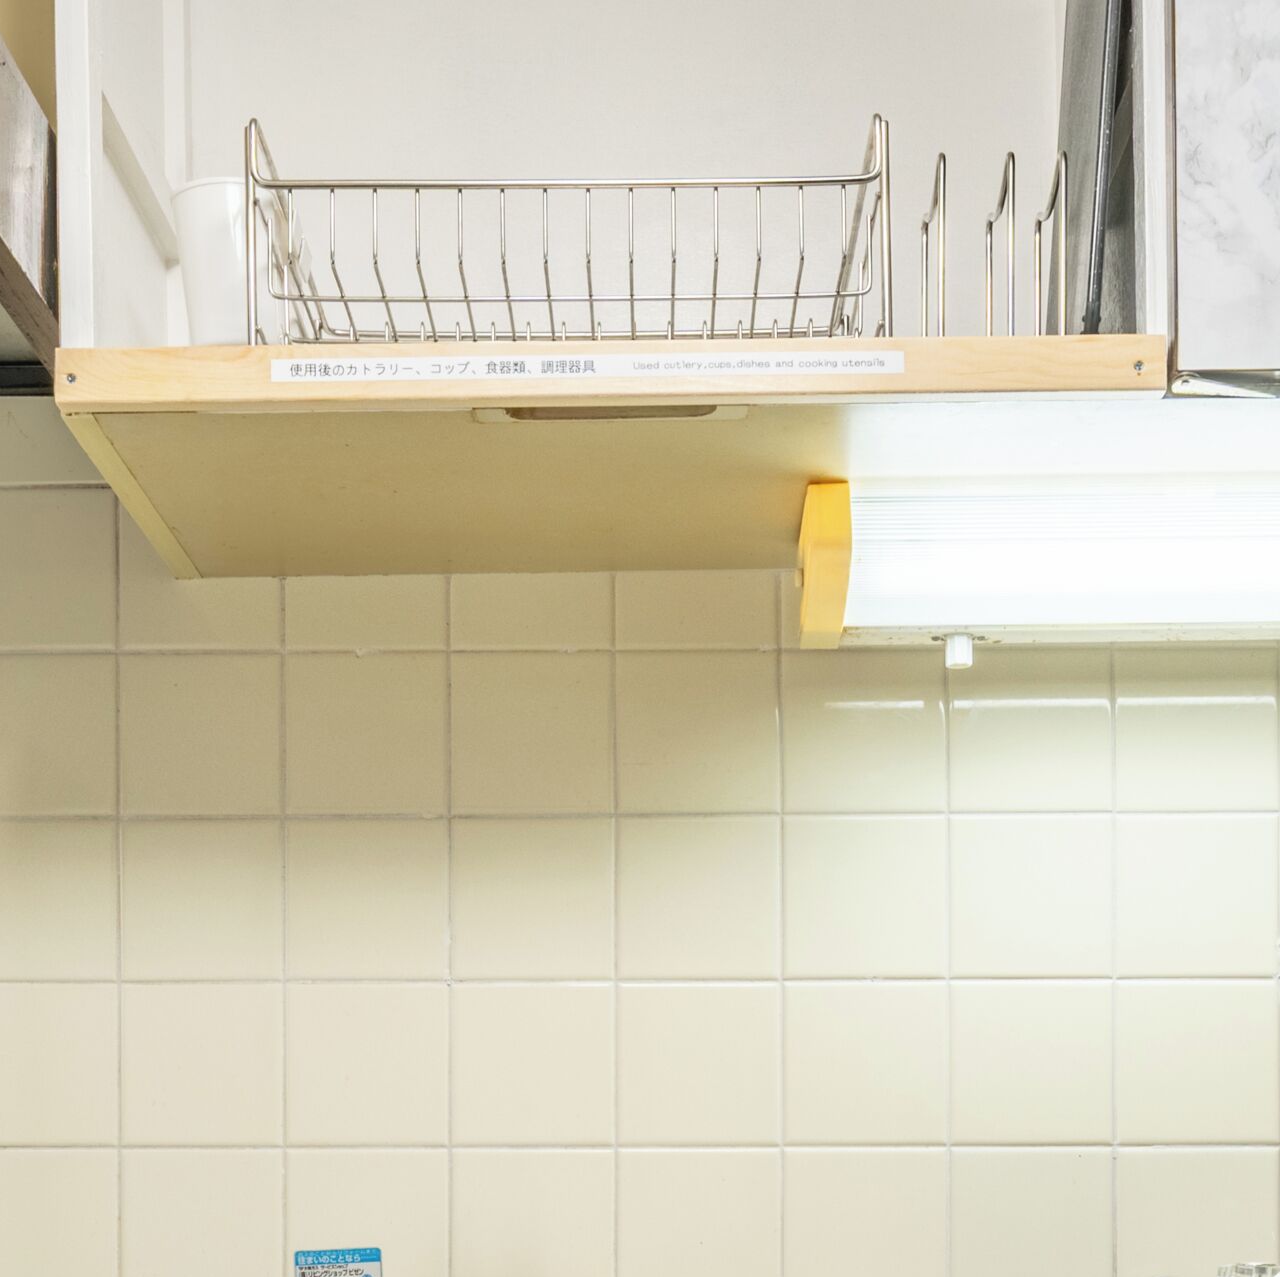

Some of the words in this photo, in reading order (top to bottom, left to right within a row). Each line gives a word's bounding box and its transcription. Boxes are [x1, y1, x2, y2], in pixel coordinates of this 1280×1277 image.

[289, 359, 597, 377] 使用後のカトラリー、コップ、食器類、調理器具
[633, 360, 660, 371] Used
[775, 359, 794, 369] and
[798, 358, 838, 369] cooking
[842, 357, 885, 368] utensils
